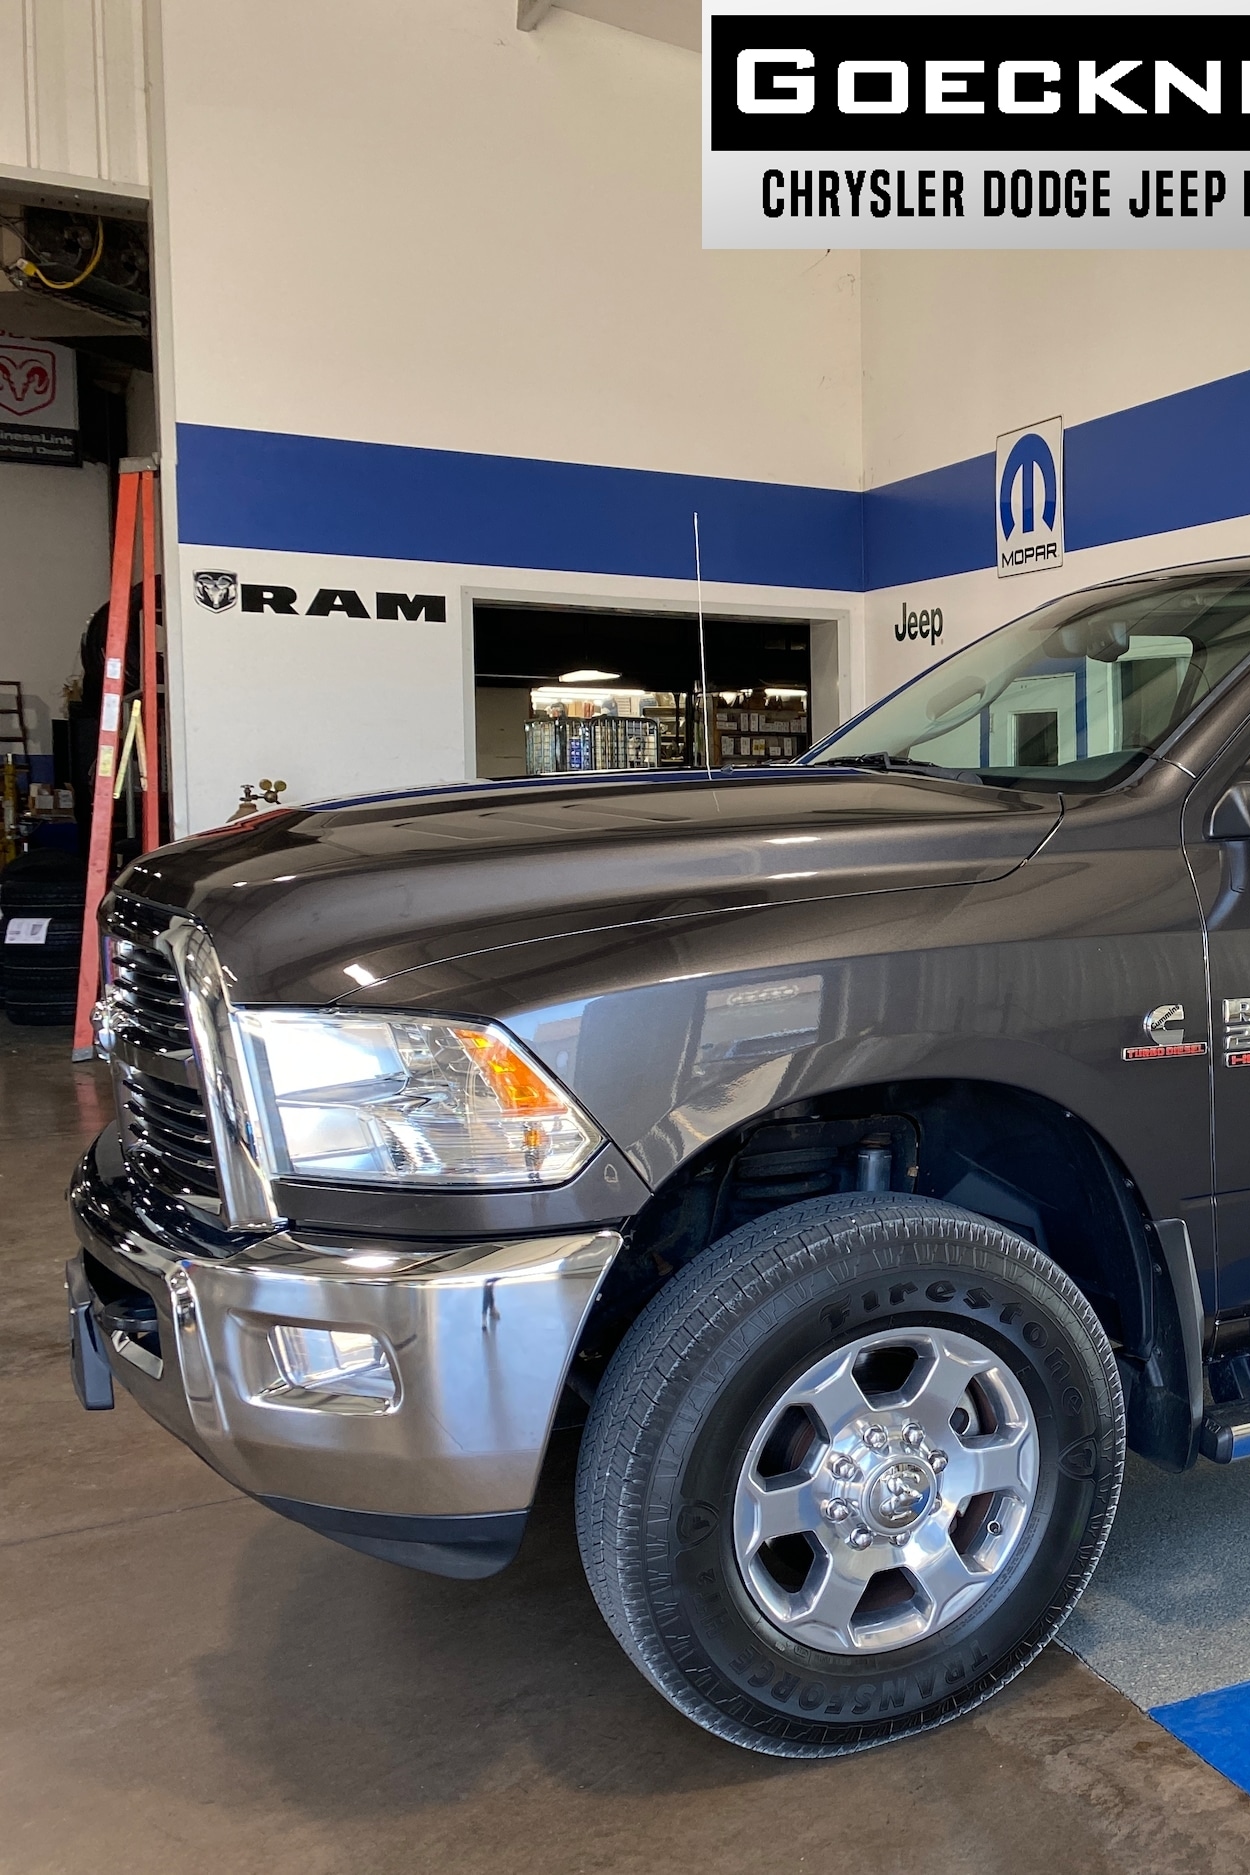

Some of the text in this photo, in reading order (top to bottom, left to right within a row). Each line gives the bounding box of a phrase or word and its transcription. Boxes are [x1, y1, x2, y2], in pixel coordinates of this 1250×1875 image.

[1002, 542, 1057, 568] MOPAR
[240, 583, 447, 623] RAM
[895, 602, 943, 646] Jeep
[819, 1280, 1084, 1414] Firestone
[728, 1640, 989, 1715] TRANSFORCE
